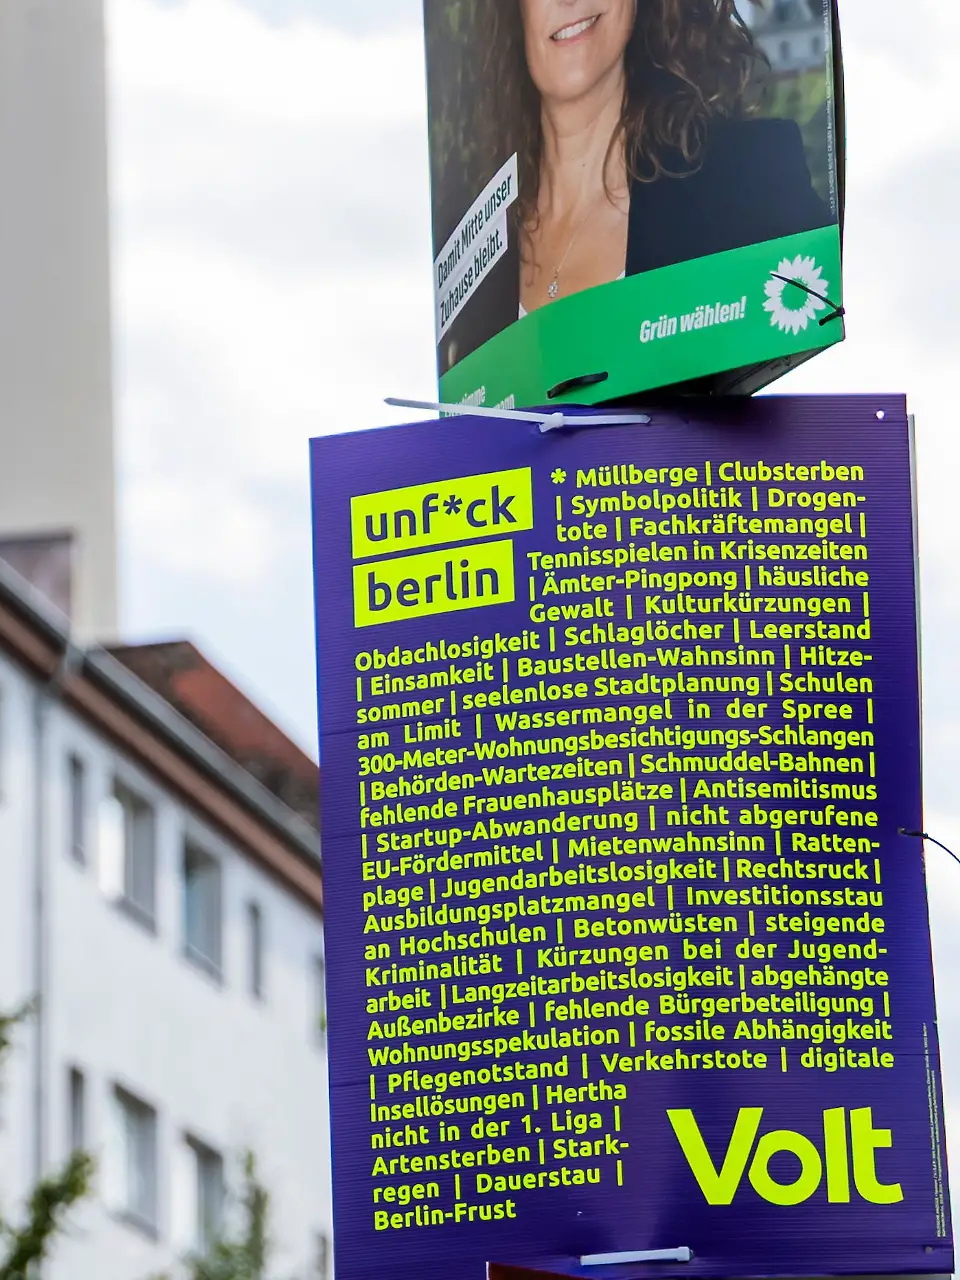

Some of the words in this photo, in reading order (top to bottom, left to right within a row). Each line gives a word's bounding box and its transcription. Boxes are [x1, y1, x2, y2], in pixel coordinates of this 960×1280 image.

[437, 239, 461, 289] Damit
[461, 212, 484, 255] Mitte
[484, 174, 512, 222] unser
[440, 266, 474, 329] Zuhause
[474, 228, 503, 280] bleibt.
[639, 314, 678, 343] Grün
[680, 295, 747, 333] wählen!
[576, 464, 699, 488] Müllberge
[718, 460, 864, 482] Clubsterben
[556, 521, 608, 543] tote
[629, 512, 853, 539] Fachkräftemangel
[571, 487, 742, 518] Symbolpolitik
[767, 487, 866, 512] Drogen-
[527, 541, 688, 571] Tennisspielen
[693, 539, 715, 561] in
[720, 539, 868, 561] Krisenzeiten
[368, 558, 500, 612] berlin
[542, 568, 738, 596] Ämter-Pingpong
[758, 565, 869, 587] häusliche
[529, 596, 614, 624] Gewalt
[645, 591, 851, 618] Kulturkürzungen
[355, 630, 540, 672] Obdachlosigkeit
[564, 619, 724, 647] Schlaglöcher
[749, 618, 871, 640] Leerstand
[371, 661, 494, 696] Einsamkeit
[517, 644, 775, 677] Baustellen-Wahnsinn
[800, 645, 873, 667] Hitze-
[357, 697, 445, 724] sommer
[462, 680, 589, 710] seelenlose
[594, 671, 760, 698] Stadtplanung
[779, 671, 873, 693] Schulen
[357, 731, 390, 750] am
[404, 718, 461, 744] Limit
[495, 698, 673, 732] Wassermangel
[687, 698, 711, 719] in
[725, 697, 768, 719] der
[782, 698, 853, 723] Spree
[358, 724, 874, 777] 300-Meter-Wohnungsbesichtigungs-Schlangen
[371, 757, 623, 801] Behörden-Wartezeiten
[640, 750, 864, 774] Schmuddel-Bahnen
[360, 797, 458, 828] fehlende
[463, 780, 674, 815] Frauenhausplätze
[693, 777, 878, 801] Antisemitismus
[376, 811, 639, 853] Startup-Abwanderung
[666, 803, 730, 826] nicht
[739, 803, 879, 830] abgerufene
[362, 840, 544, 881] EU-Fördermittel
[568, 830, 765, 858] Mietenwahnsinn
[791, 832, 880, 853] Ratten-
[363, 885, 424, 912] plage
[441, 857, 717, 899] Jugendarbeitslosigkeit
[736, 857, 869, 880] Rechtsruck
[363, 885, 655, 934] Ausbildungsplatzmangel
[687, 884, 883, 907] Investitionsstau
[364, 943, 391, 961] an
[400, 923, 547, 956] Hochschulen
[574, 912, 738, 939] Betonwüsten
[765, 911, 885, 937] steigende
[365, 953, 503, 987] Kriminalität
[537, 944, 669, 968] Kürzungen
[682, 937, 722, 960] bei
[735, 937, 777, 959] der
[788, 938, 887, 964] Jugend-
[366, 987, 431, 1014] arbeit
[451, 964, 734, 1005] Langzeitarbeitslosigkeit
[751, 964, 889, 991] abgehängte
[367, 1005, 520, 1041] Außenbezirke
[544, 994, 650, 1022] fehlende
[659, 991, 874, 1018] Bürgerbeteiligung
[367, 1025, 620, 1067] Wohnungsspekulation
[644, 1019, 726, 1042] fossile
[733, 1018, 893, 1044] Abhängigkeit
[387, 1055, 569, 1094] Pflegenotstand
[600, 1048, 768, 1073] Verkehrstote
[800, 1046, 895, 1073] digitale
[370, 1091, 525, 1122] Insellösungen
[545, 1079, 627, 1105] Hertha
[371, 1124, 430, 1149] nicht
[439, 1121, 461, 1143] in
[470, 1117, 511, 1140] der
[521, 1114, 541, 1134] 1.
[551, 1109, 603, 1135] Liga
[371, 1143, 531, 1177] Artensterben
[553, 1133, 629, 1159] Stark-
[666, 1106, 904, 1206] Volt
[373, 1182, 440, 1206] regen
[476, 1167, 601, 1194] Dauerstau
[374, 1199, 517, 1231] Berlin-Frust
